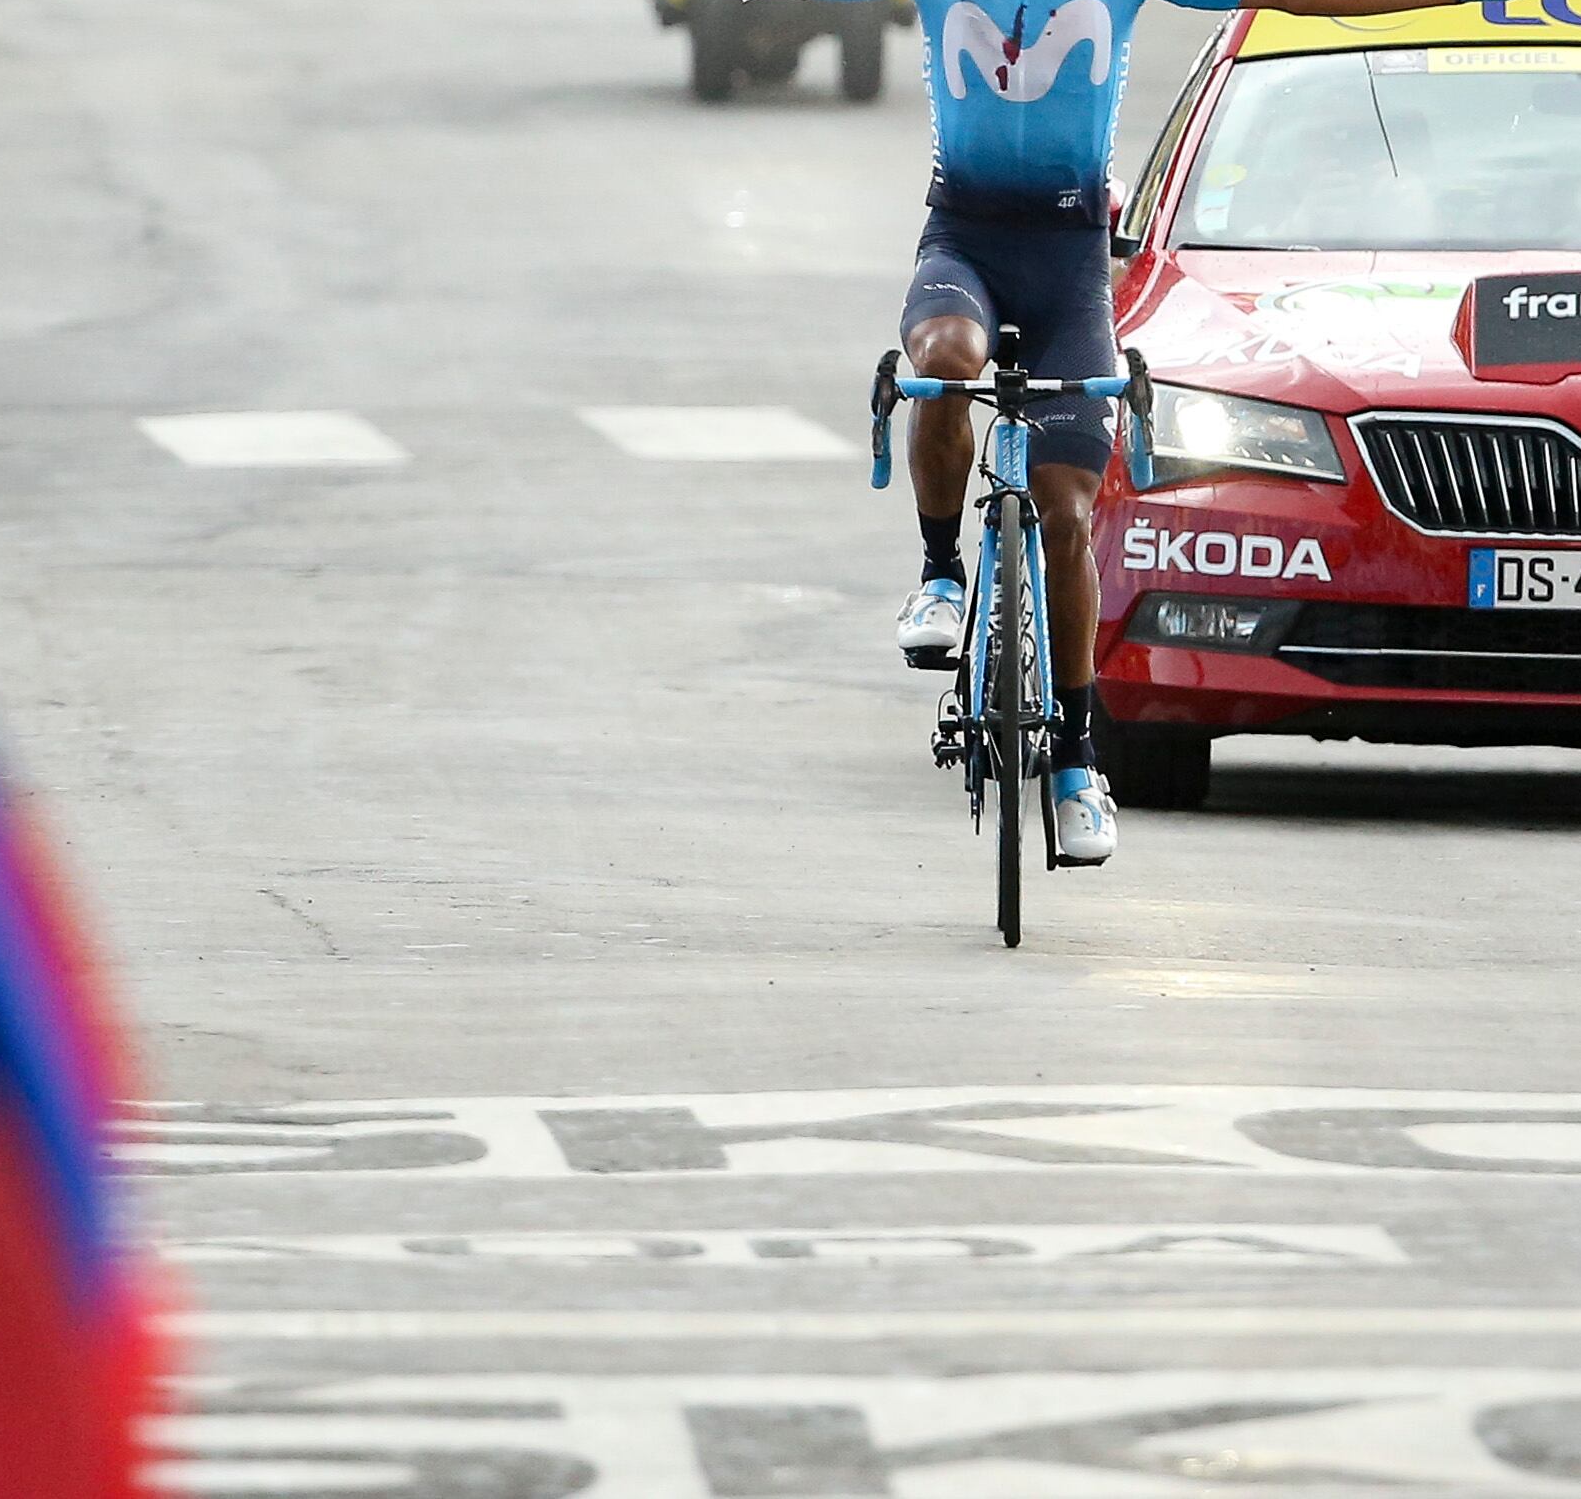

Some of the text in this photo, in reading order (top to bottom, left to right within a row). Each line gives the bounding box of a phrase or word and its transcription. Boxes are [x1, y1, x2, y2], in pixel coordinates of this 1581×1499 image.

[1444, 51, 1566, 67] OFFICIEL
[1122, 517, 1333, 582] ŠKODA
[1476, 583, 1487, 599] F
